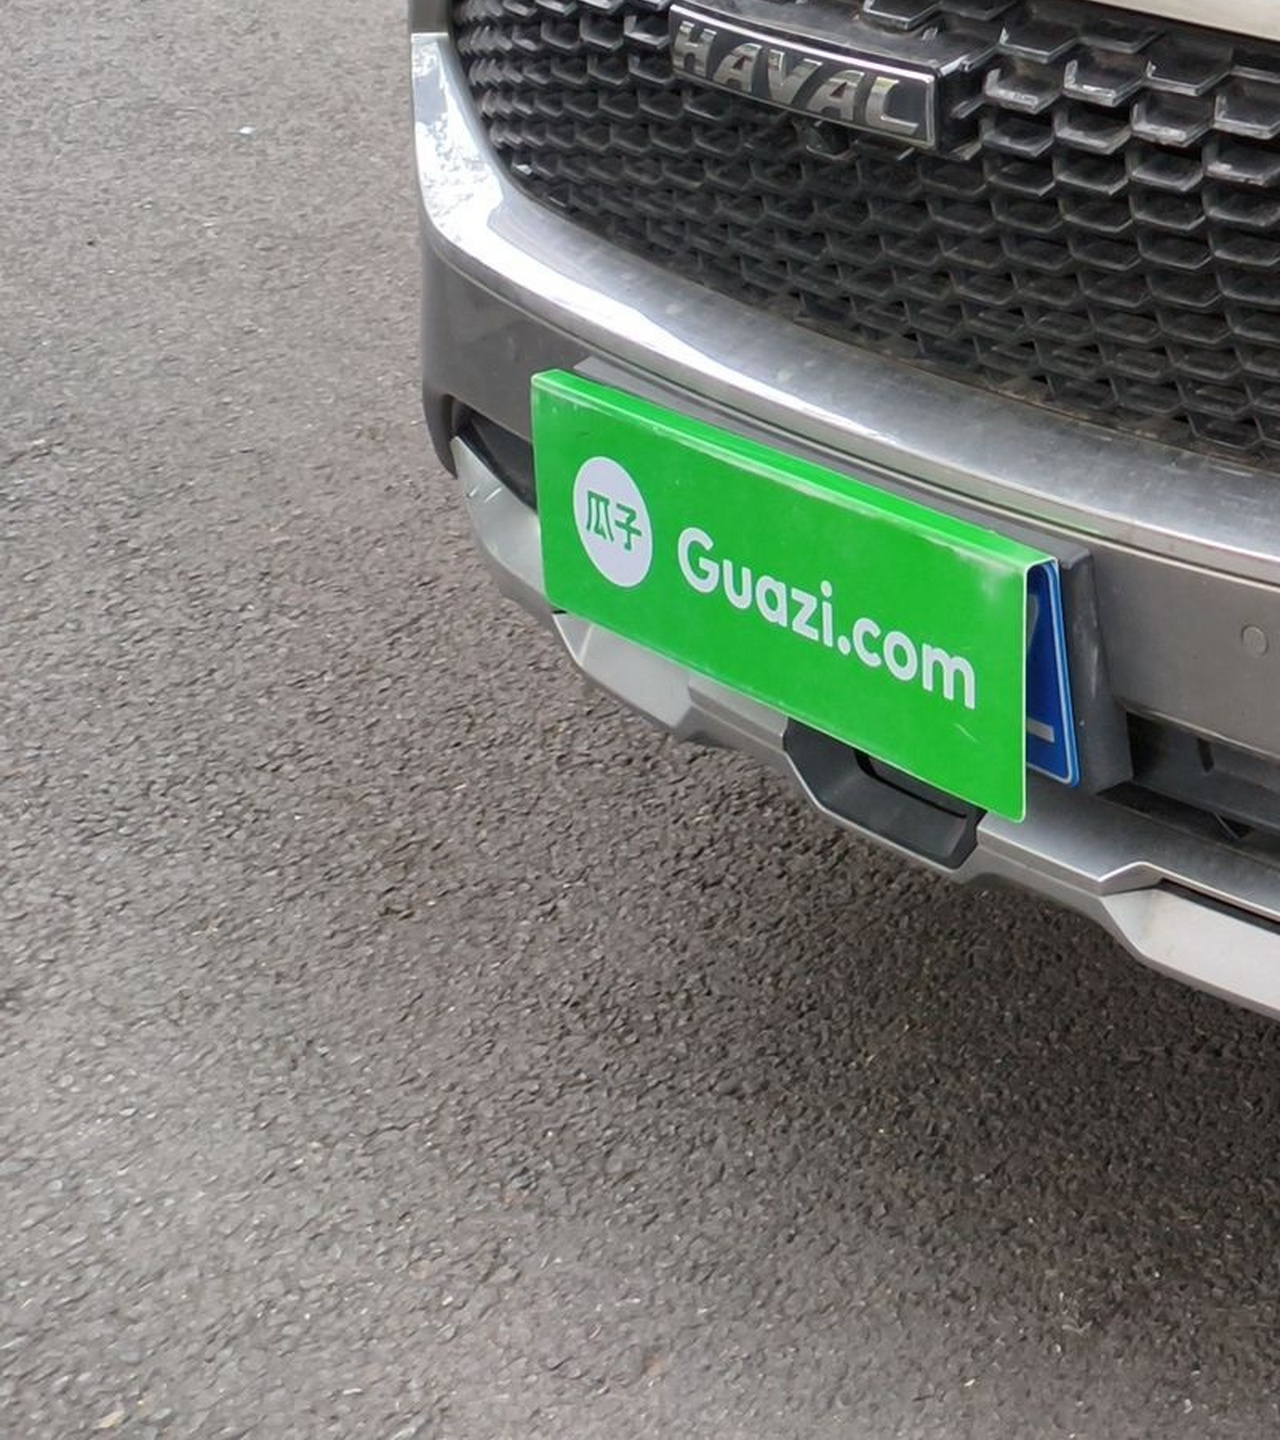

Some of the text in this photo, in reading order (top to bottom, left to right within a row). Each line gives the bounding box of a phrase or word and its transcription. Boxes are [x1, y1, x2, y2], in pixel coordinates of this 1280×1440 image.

[672, 20, 919, 136] HAVAL
[584, 488, 643, 551] 瓜子
[677, 526, 977, 710] Guazi.com
